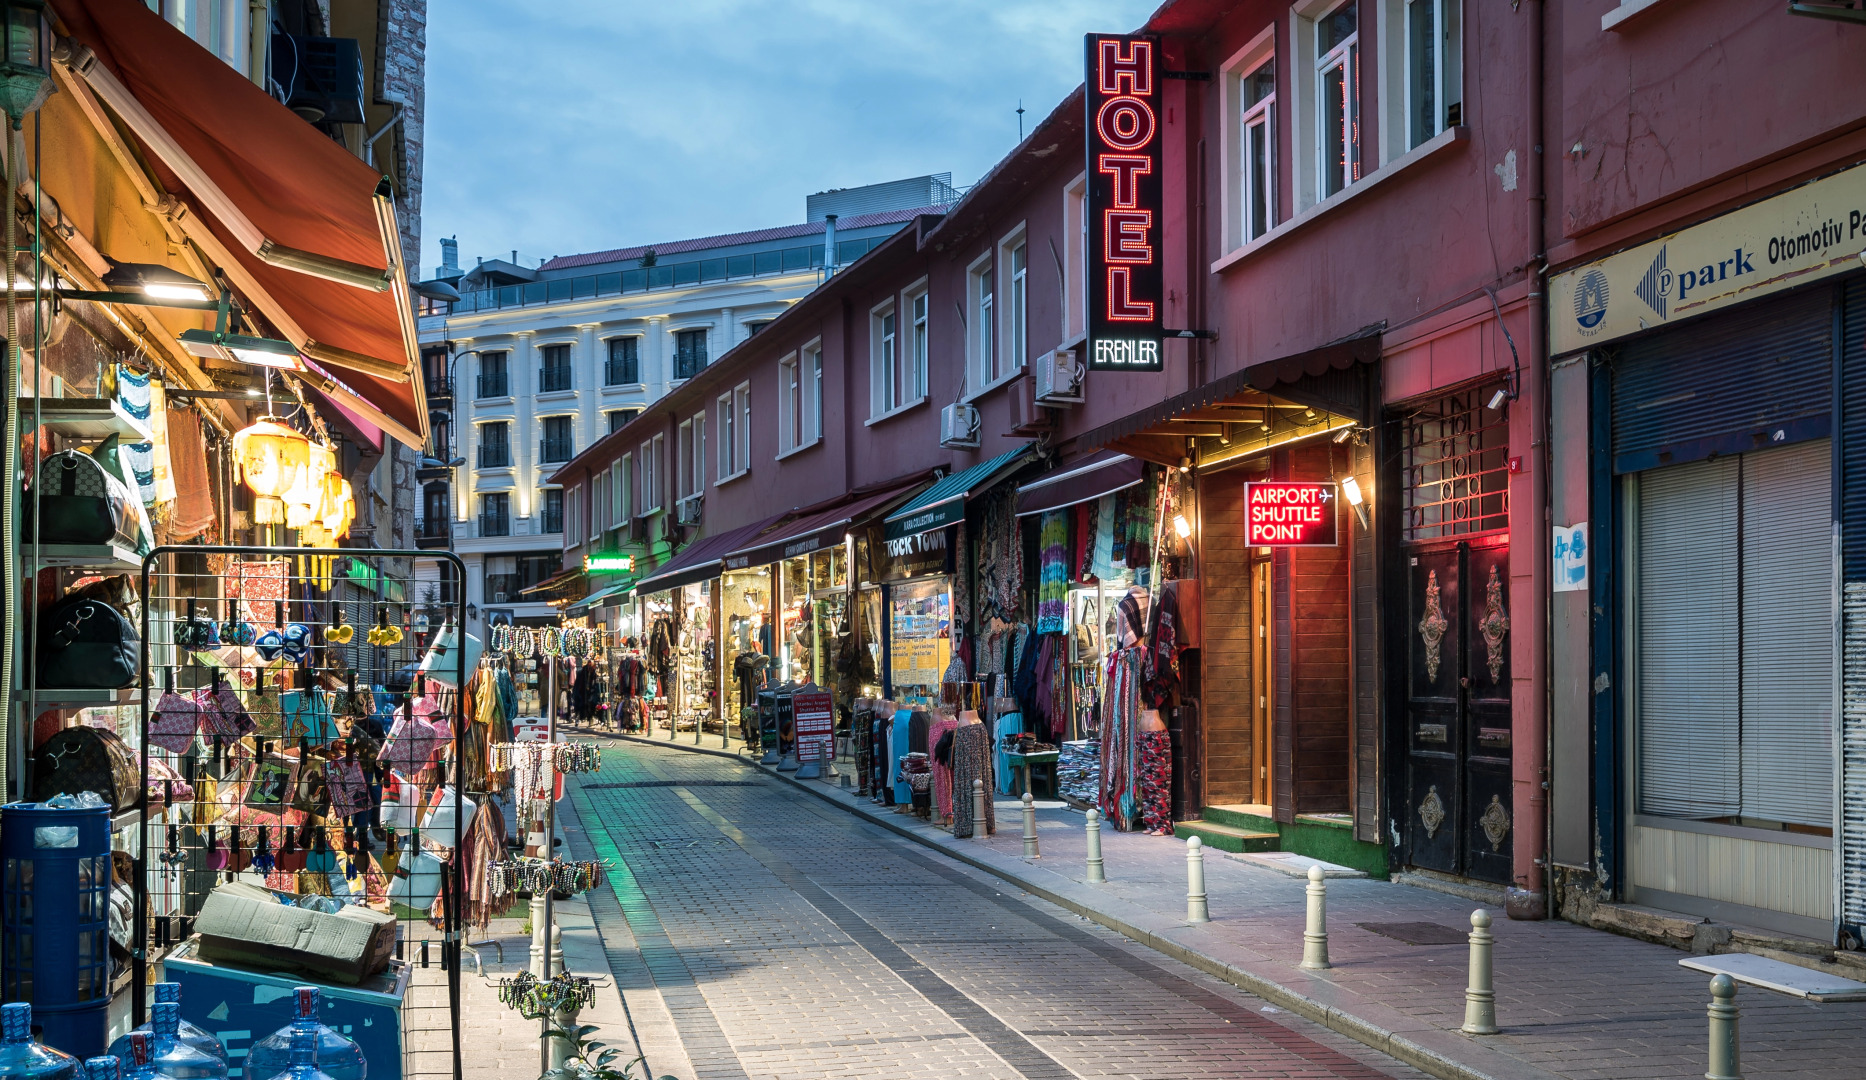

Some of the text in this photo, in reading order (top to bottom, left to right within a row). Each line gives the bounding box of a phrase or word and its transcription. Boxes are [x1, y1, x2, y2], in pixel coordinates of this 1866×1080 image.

[1097, 40, 1156, 321] HOTEL
[1768, 218, 1844, 265] Otomotiv
[1677, 247, 1756, 301] park
[1095, 339, 1158, 364] ERENLER
[1251, 488, 1319, 504] AIRPORT
[1252, 506, 1321, 522] SHUTTLE
[888, 530, 946, 557] ROCK TOWN
[1252, 524, 1304, 540] POINT
